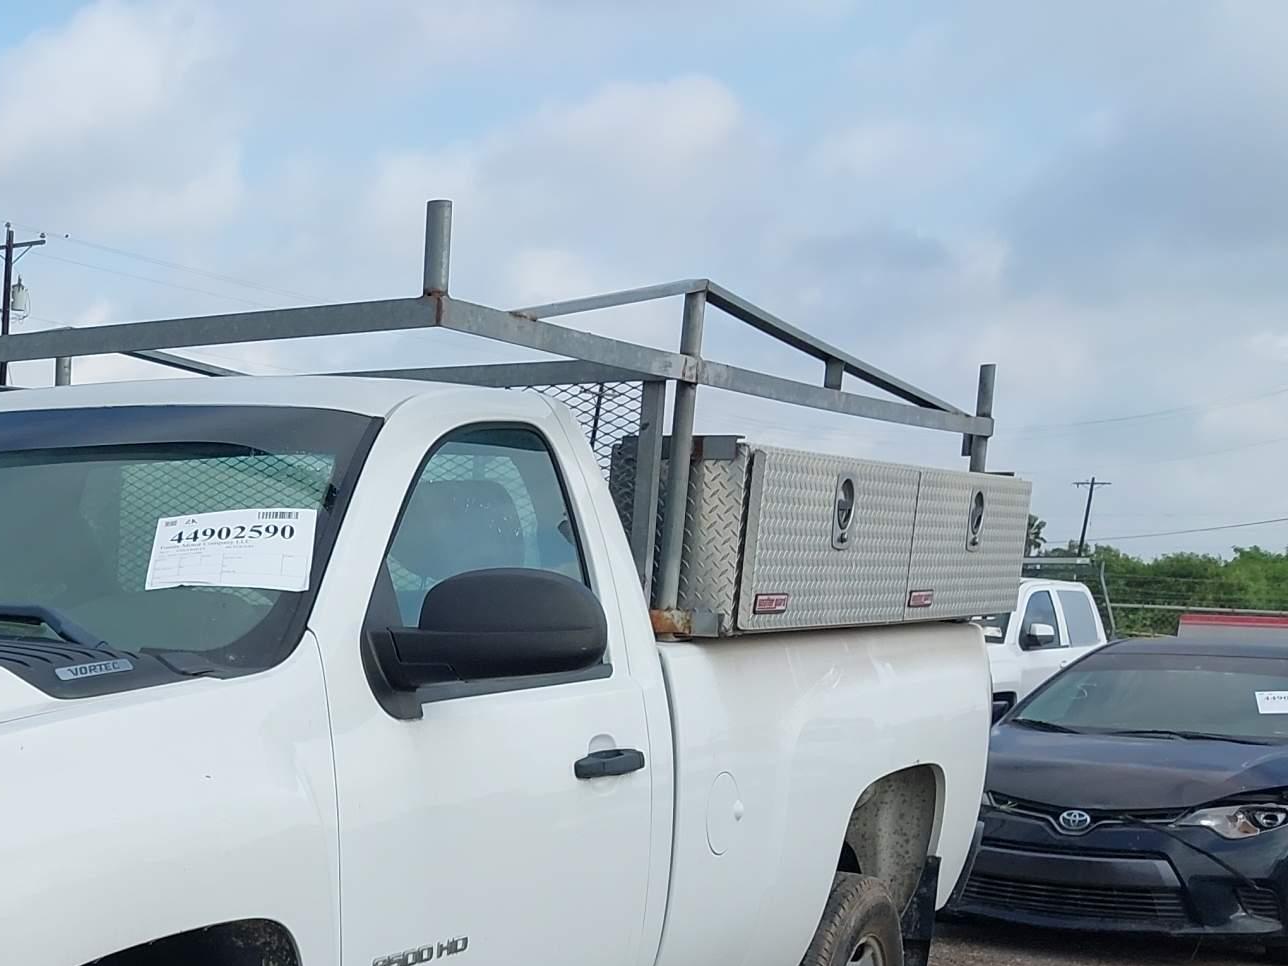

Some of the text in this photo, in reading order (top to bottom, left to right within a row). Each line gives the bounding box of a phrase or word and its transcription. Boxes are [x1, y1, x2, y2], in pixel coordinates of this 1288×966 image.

[170, 524, 295, 544] 44902590
[68, 661, 121, 677] VORTEC
[436, 936, 469, 959] HD
